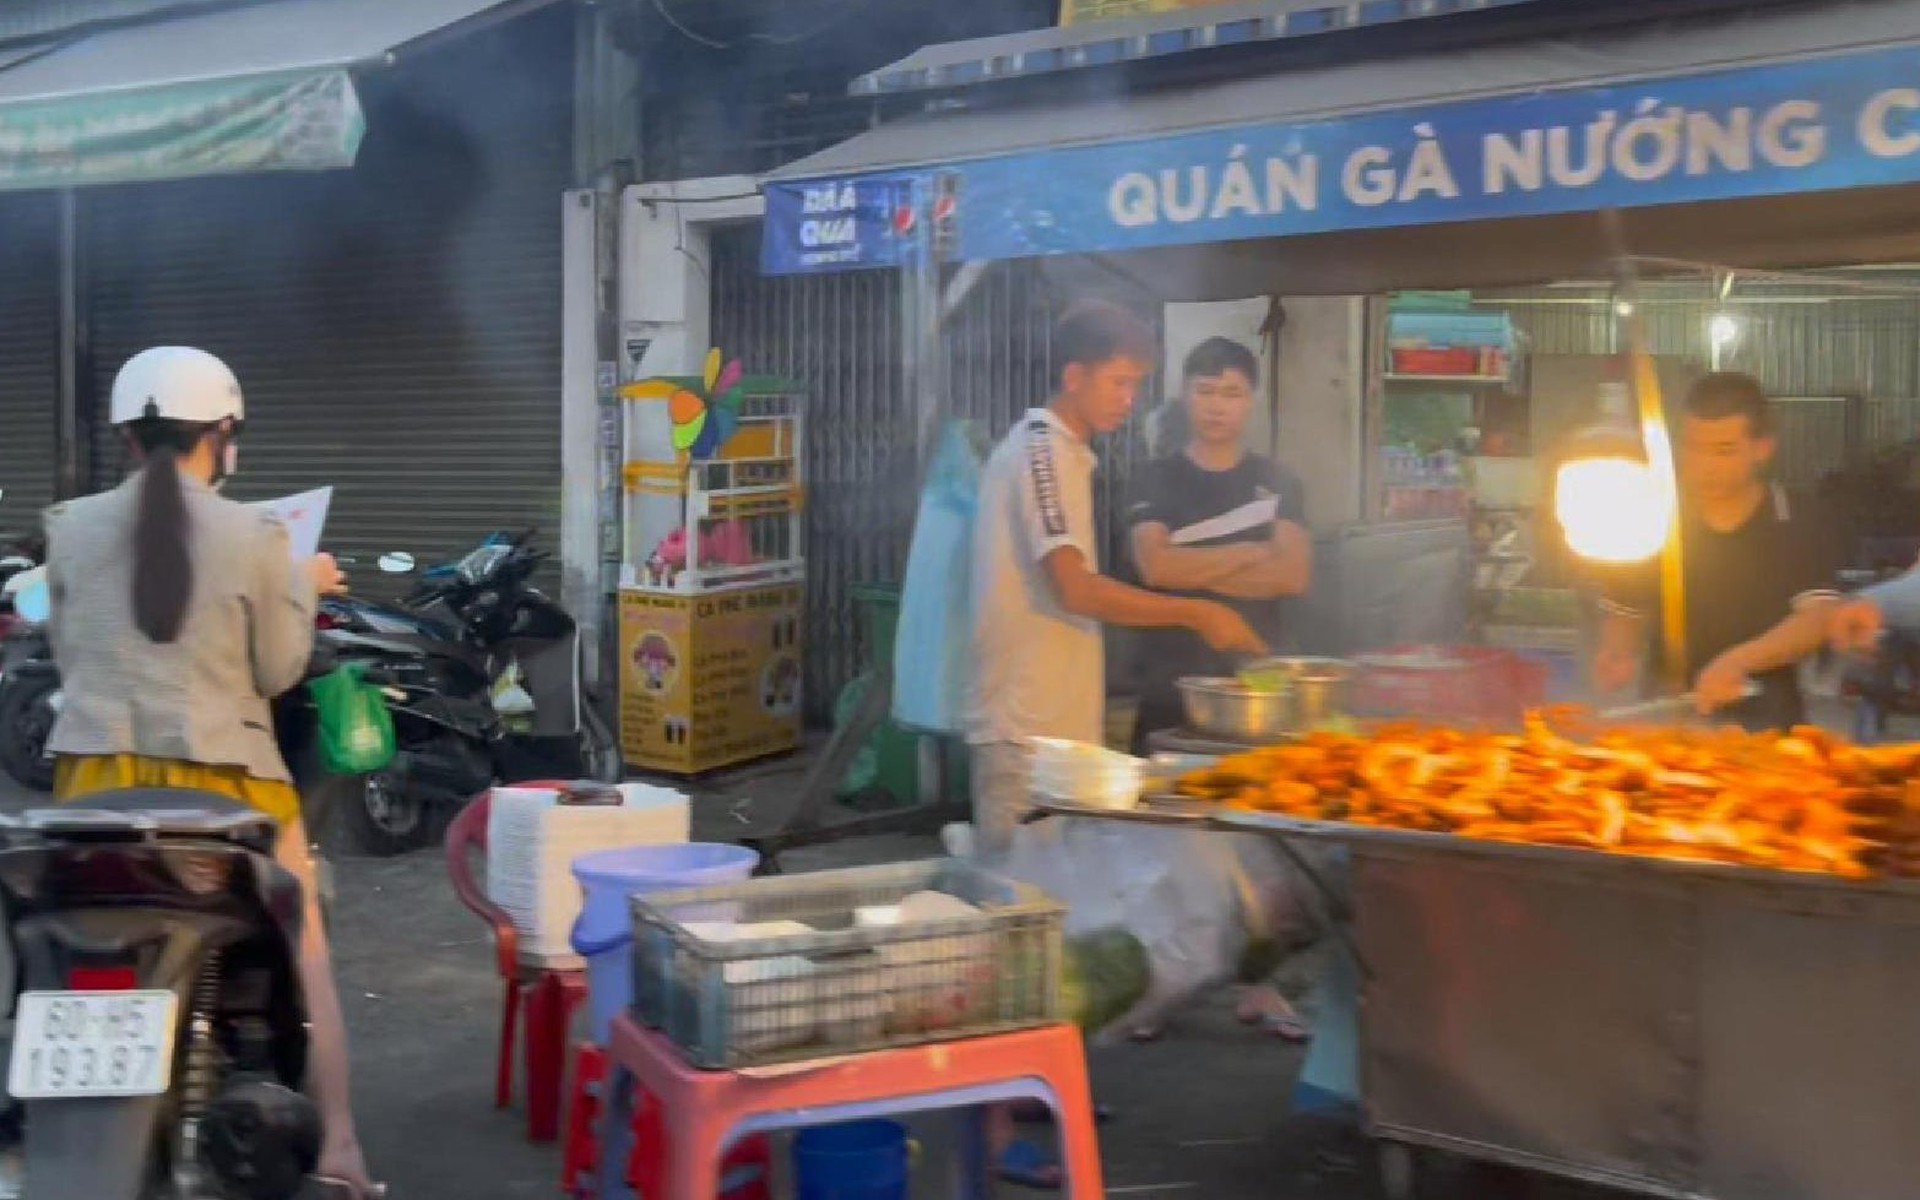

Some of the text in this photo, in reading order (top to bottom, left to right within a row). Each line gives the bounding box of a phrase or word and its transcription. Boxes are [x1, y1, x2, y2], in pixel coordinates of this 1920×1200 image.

[1108, 144, 1319, 226] QUÁN
[1341, 122, 1461, 206] GÀ
[1482, 96, 1826, 194] NƯỚNG
